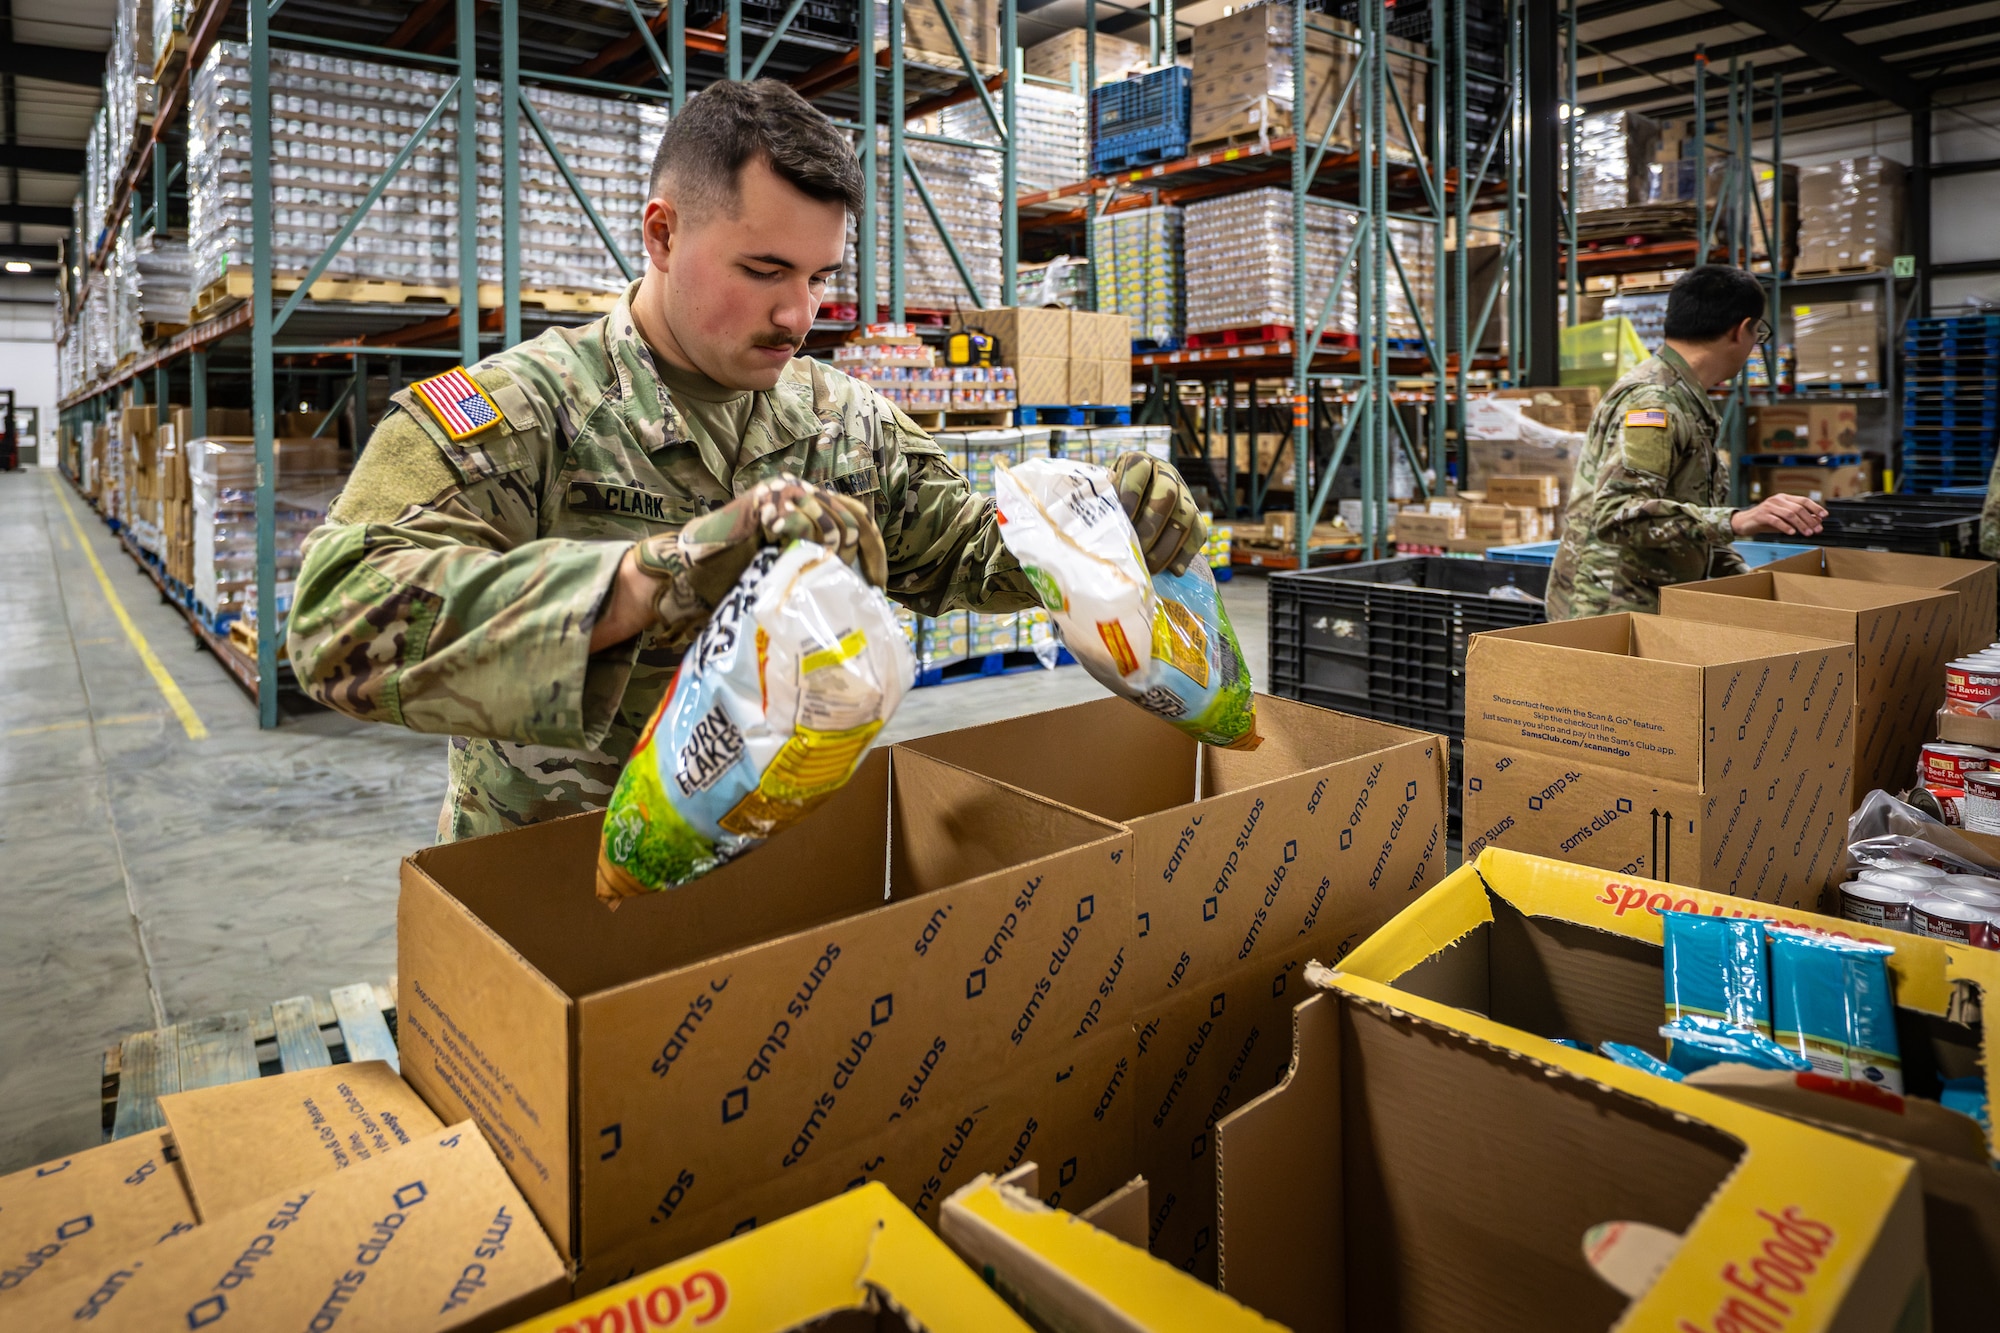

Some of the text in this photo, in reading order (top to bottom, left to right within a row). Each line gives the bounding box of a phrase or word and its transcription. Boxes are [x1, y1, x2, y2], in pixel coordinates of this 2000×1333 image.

[1897, 260, 1911, 274] N
[606, 488, 664, 519] CLARK
[1493, 694, 1511, 704] Shop
[1512, 698, 1539, 709] contact
[1540, 703, 1554, 712] free
[1556, 705, 1572, 715] with
[1573, 709, 1586, 718] the
[1588, 712, 1606, 721] Scan
[1633, 719, 1665, 732] feature.
[1743, 666, 1770, 725] sam's club
[1815, 687, 1839, 742] sam's club
[1947, 684, 1991, 696] eef Ravioli
[1483, 712, 1496, 721] Just
[1496, 715, 1513, 724] scan
[1522, 720, 1536, 729] you
[1537, 723, 1555, 733] shop
[1557, 726, 1571, 735] and
[1572, 729, 1587, 739] pay
[1588, 731, 1595, 739] in
[1596, 733, 1609, 743] the
[1611, 736, 1635, 747] Sam's
[1636, 741, 1656, 751] Club
[1657, 747, 1676, 756] app.
[1521, 729, 1631, 757] SamsClub.com/scanandgo
[1533, 712, 1616, 734] Skip the checkout line.
[1753, 713, 1778, 771] sam's club
[676, 725, 745, 795] FLAKES
[1928, 767, 1945, 777] Beef
[1974, 783, 1986, 791] Mini
[1350, 788, 1370, 827] club
[1542, 778, 1567, 801] club
[1780, 773, 1806, 830] sam's club
[1799, 783, 1823, 842] sam's club
[1978, 787, 1997, 798] Ravioli
[1162, 824, 1195, 884] sam's
[1213, 797, 1265, 895] sam's club
[1368, 803, 1409, 891] sam's club
[1468, 815, 1515, 856] sam's clu
[1559, 808, 1618, 853] sam's club
[1713, 833, 1730, 869] sam's
[1727, 805, 1741, 834] club
[1734, 816, 1762, 880] sam's club
[1816, 828, 1829, 855] club
[1304, 875, 1331, 929] sam's
[1408, 862, 1425, 892] clu
[1755, 862, 1770, 891] club
[983, 912, 1018, 966] club
[1238, 864, 1288, 961] sam's club
[1929, 923, 1964, 936] Beef Ravioli
[1938, 920, 1952, 928] Mini
[1010, 923, 1081, 1046] sam's club
[651, 993, 713, 1079] sam's
[746, 942, 842, 1083] sam's club
[1073, 999, 1101, 1039] clu
[782, 1029, 874, 1169] sam's club
[899, 1035, 947, 1112] sam's
[1093, 1056, 1129, 1122] sam's
[1153, 1019, 1214, 1129] sam's club
[938, 1115, 977, 1174] club
[212, 1234, 275, 1291] club
[306, 1269, 366, 1333] am's
[357, 1211, 411, 1267] club
[1721, 1205, 1835, 1316] Foods
[440, 1263, 487, 1315] clu
